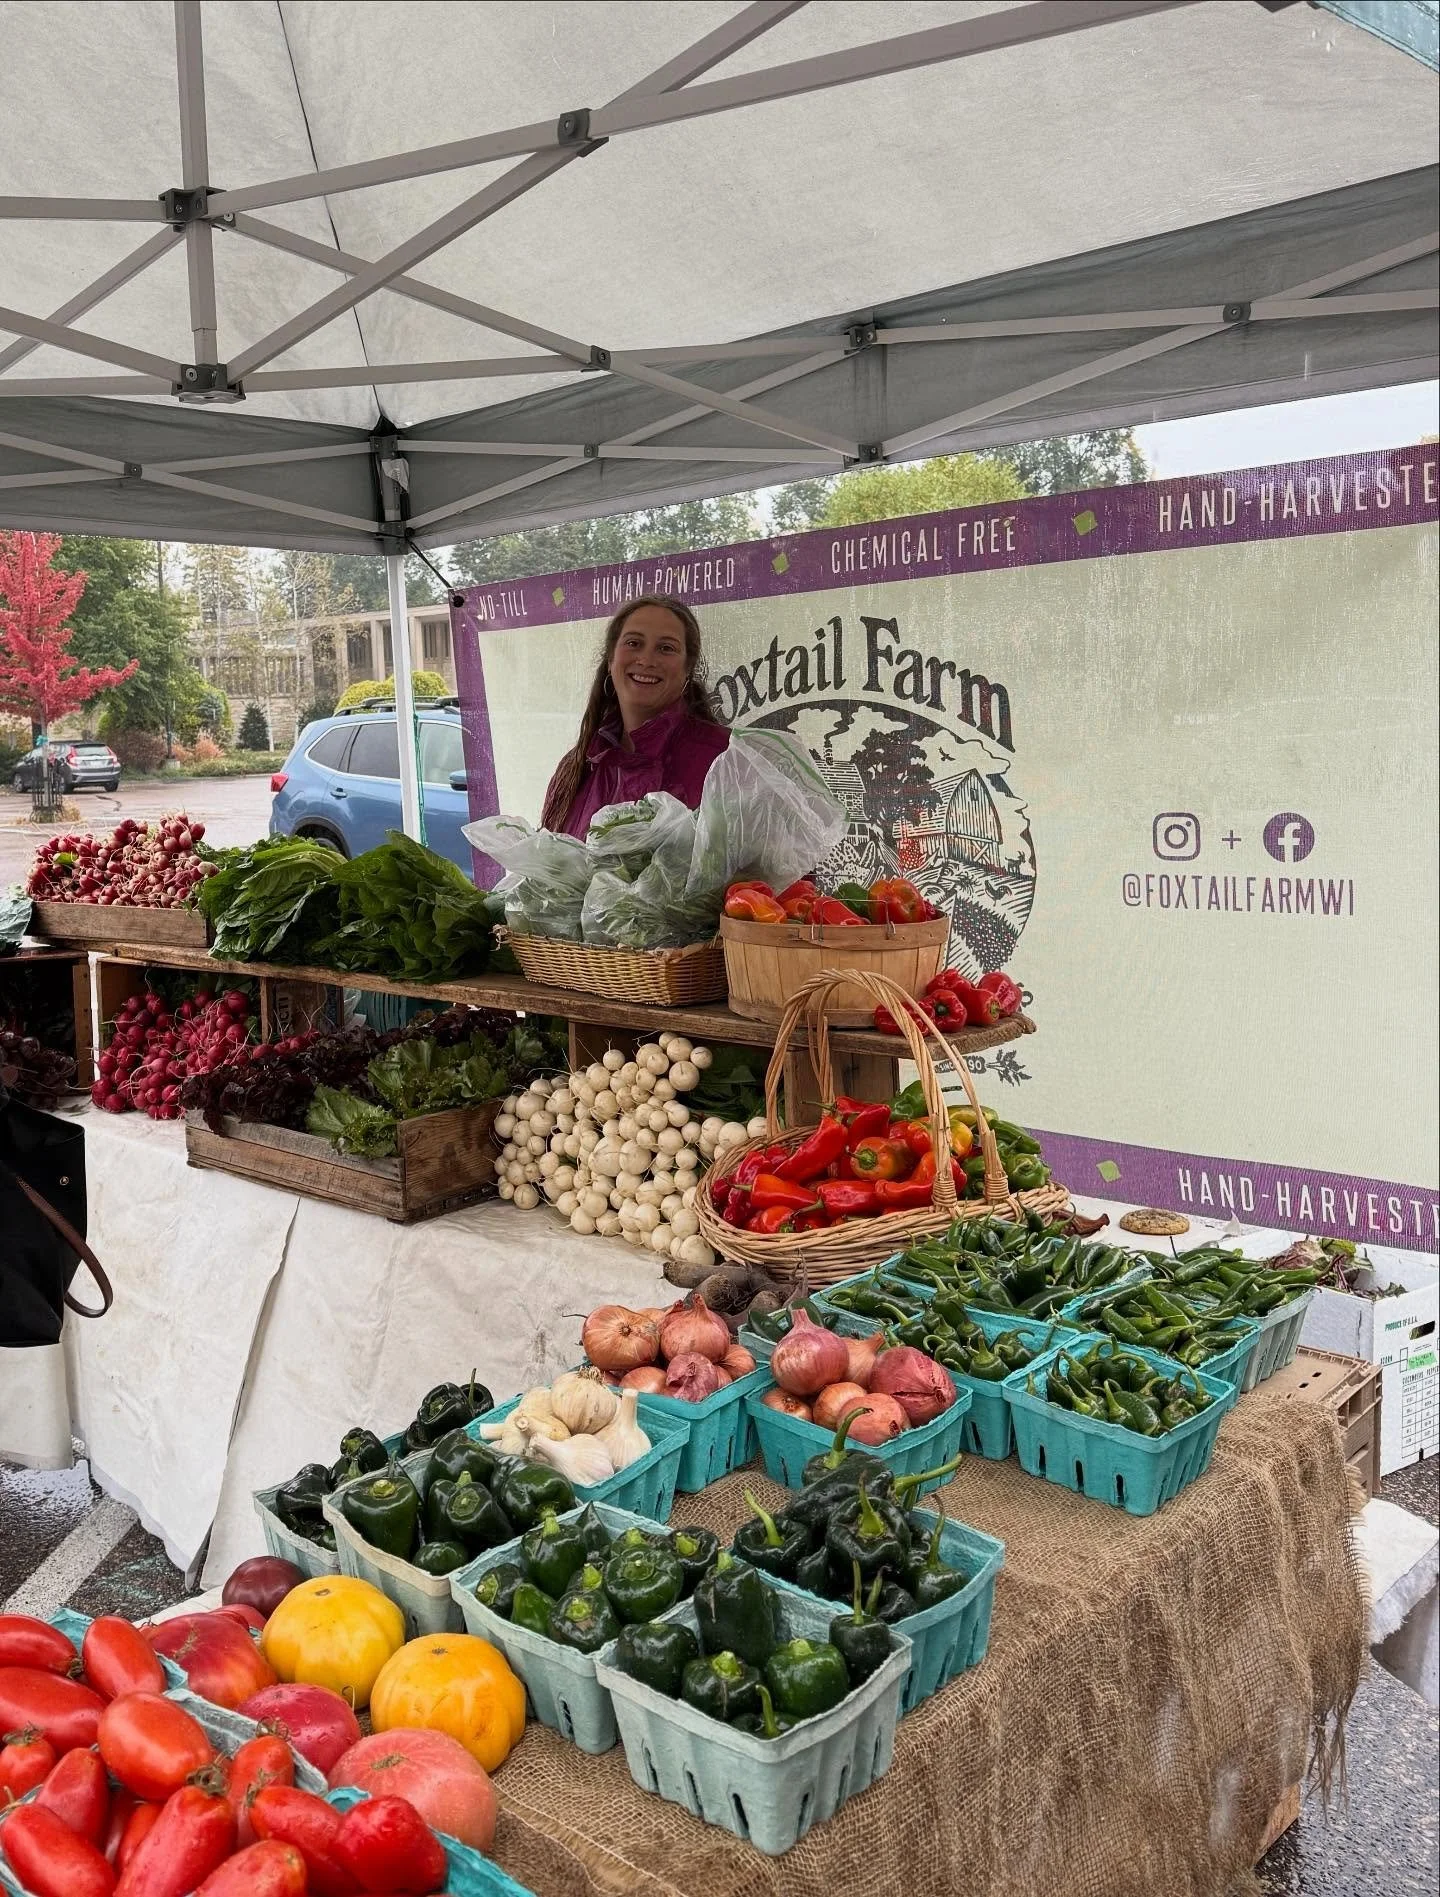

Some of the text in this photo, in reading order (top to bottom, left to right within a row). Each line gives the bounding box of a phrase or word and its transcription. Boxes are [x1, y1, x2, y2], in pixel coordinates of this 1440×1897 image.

[1158, 460, 1439, 533] HAND-HARVESTE
[830, 515, 1016, 574] CHEMICAL FREE
[477, 589, 528, 621] NO-TILL
[592, 557, 736, 606] HUMAN-POWERED
[710, 615, 1016, 753] oxtail Farm
[1122, 873, 1354, 916] @FOXTAILFARMWI
